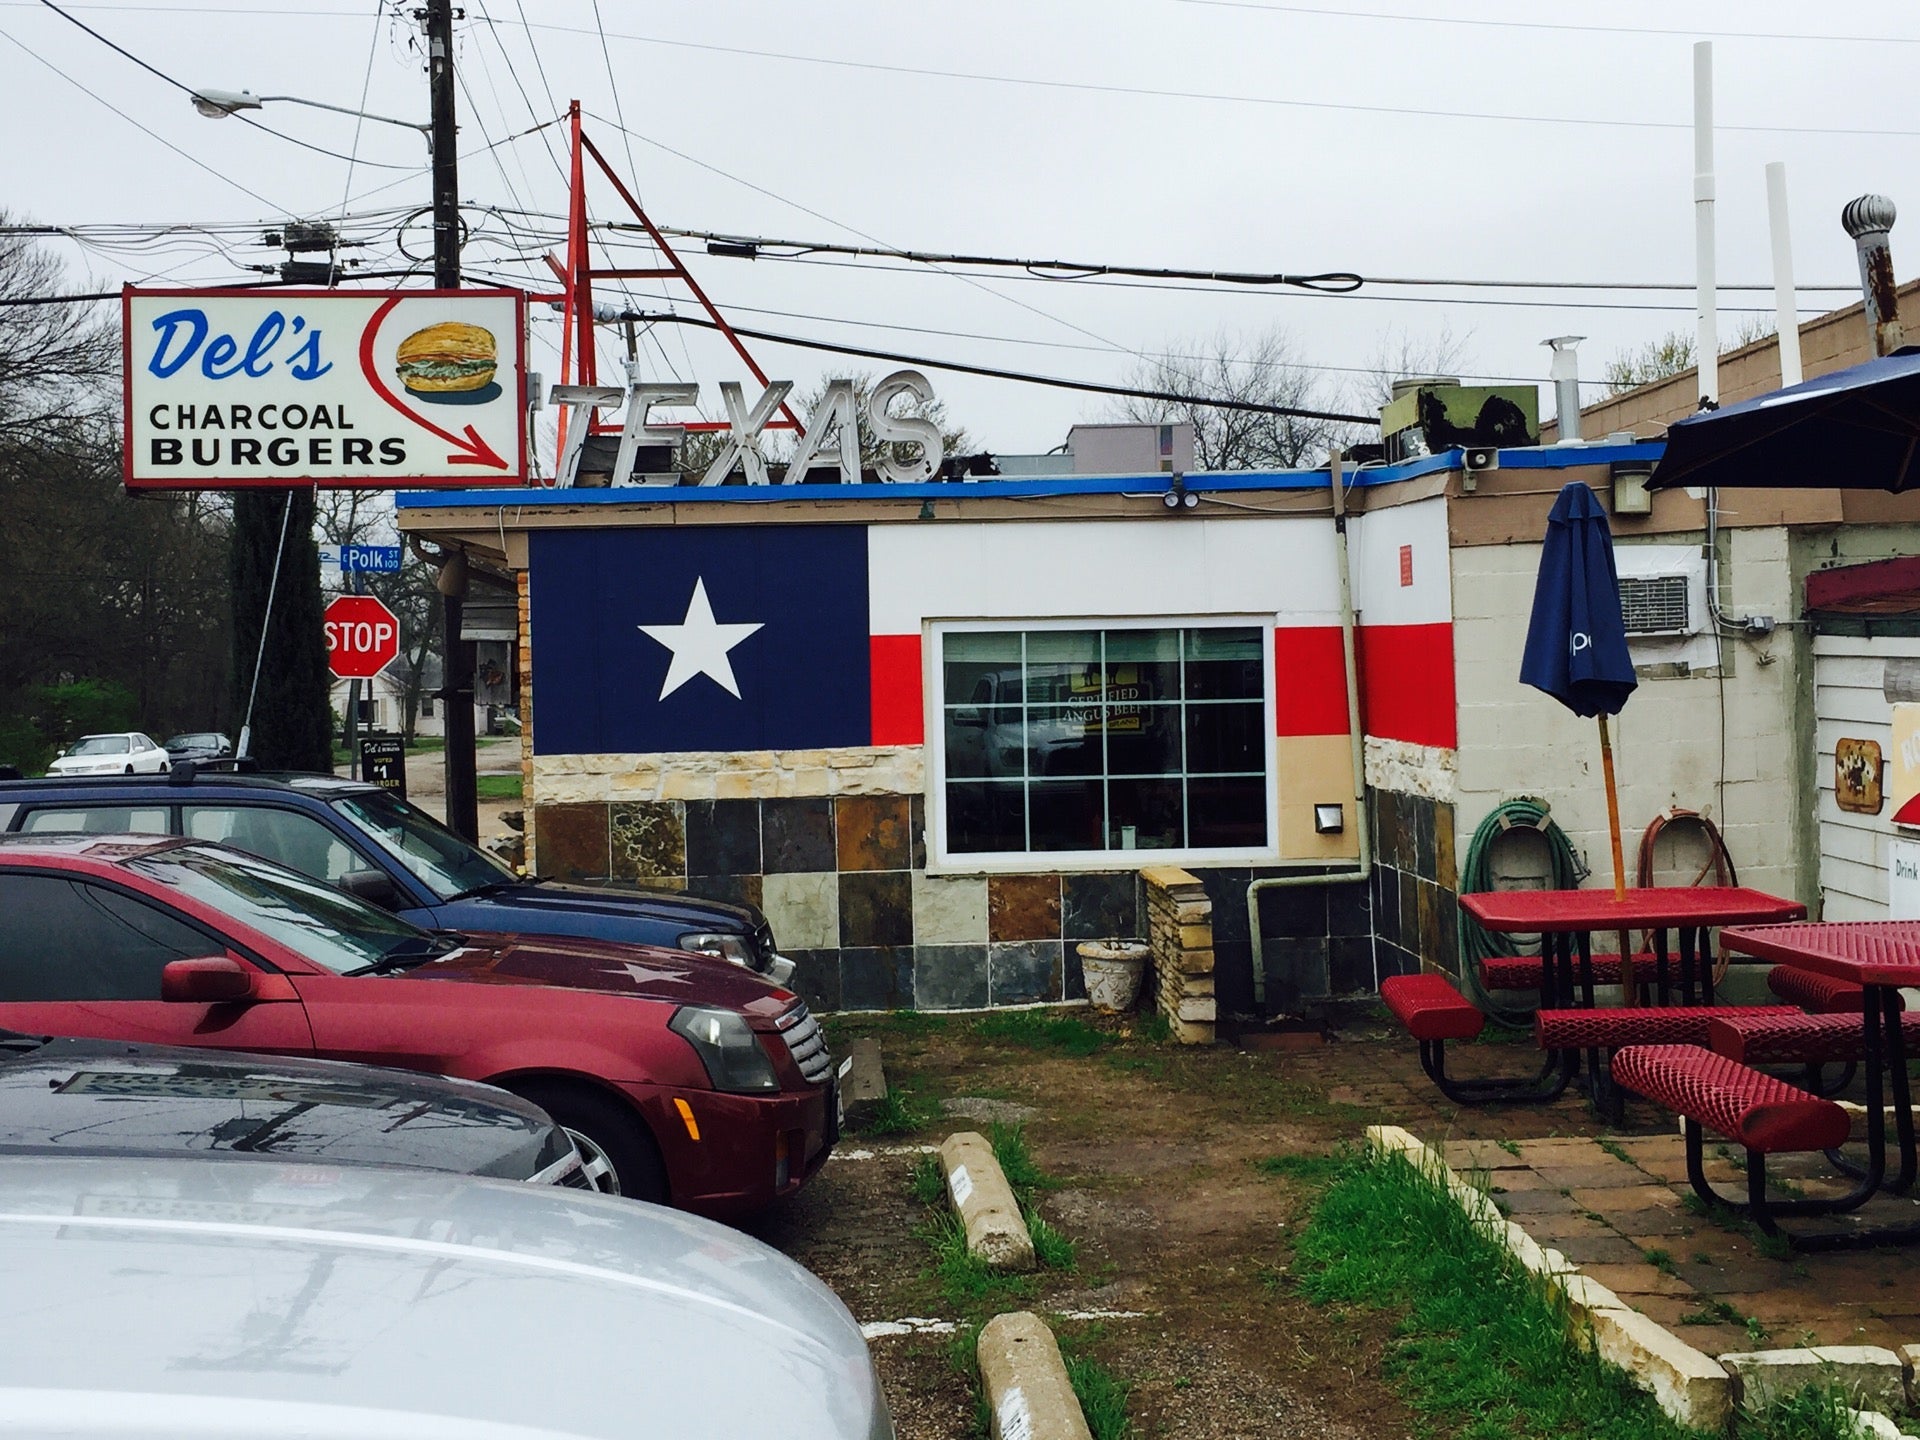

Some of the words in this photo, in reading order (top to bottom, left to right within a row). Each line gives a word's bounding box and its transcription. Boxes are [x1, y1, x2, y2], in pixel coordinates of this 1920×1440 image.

[148, 308, 334, 381] Del's
[149, 404, 354, 430] CHARCOAL
[549, 369, 943, 487] TEXAS
[150, 437, 407, 466] BURGERS
[349, 549, 383, 568] Polk
[388, 550, 399, 559] ST
[385, 560, 398, 568] 100
[323, 621, 392, 652] STOP
[1067, 688, 1139, 707] CERTFIED
[1063, 706, 1111, 721] ANGUS
[1114, 703, 1141, 716] BEEF
[1896, 859, 1919, 880] Drink
